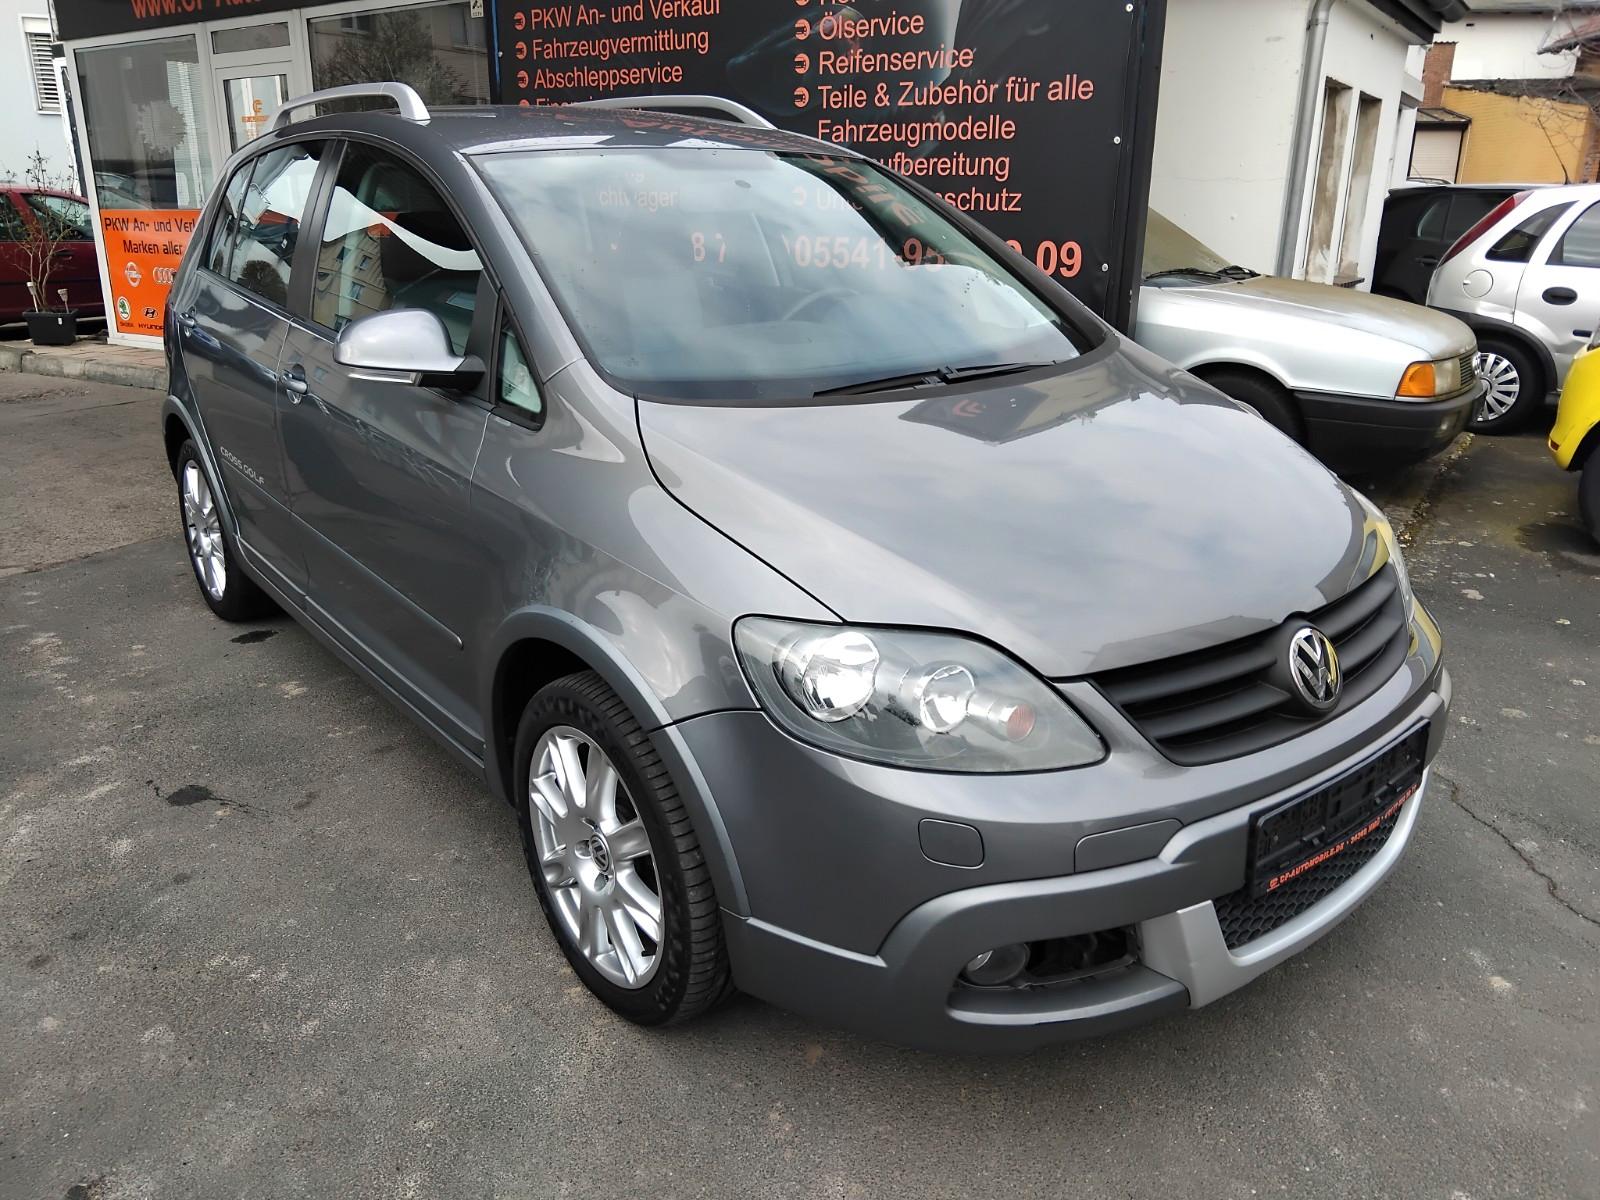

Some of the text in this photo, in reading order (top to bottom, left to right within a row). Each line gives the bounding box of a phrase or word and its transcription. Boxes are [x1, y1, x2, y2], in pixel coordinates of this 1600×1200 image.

[531, 6, 572, 30] PKW
[576, 4, 606, 27] An-
[611, 0, 644, 23] und
[819, 11, 925, 41] Ölservice
[532, 29, 710, 61] Fahrzeugvermittlung
[818, 43, 974, 75] Reifenservice
[534, 61, 683, 91] Abschleppservice
[817, 74, 1094, 109] Teile & Zubehör für alle
[817, 114, 1016, 148] Fahrzeugmodelle
[871, 152, 1010, 182] ufbereitung
[935, 186, 1022, 211] schutz
[104, 217, 195, 233] PKW An- und Ver
[123, 240, 182, 255] Marken aller
[243, 464, 265, 485] GOLF
